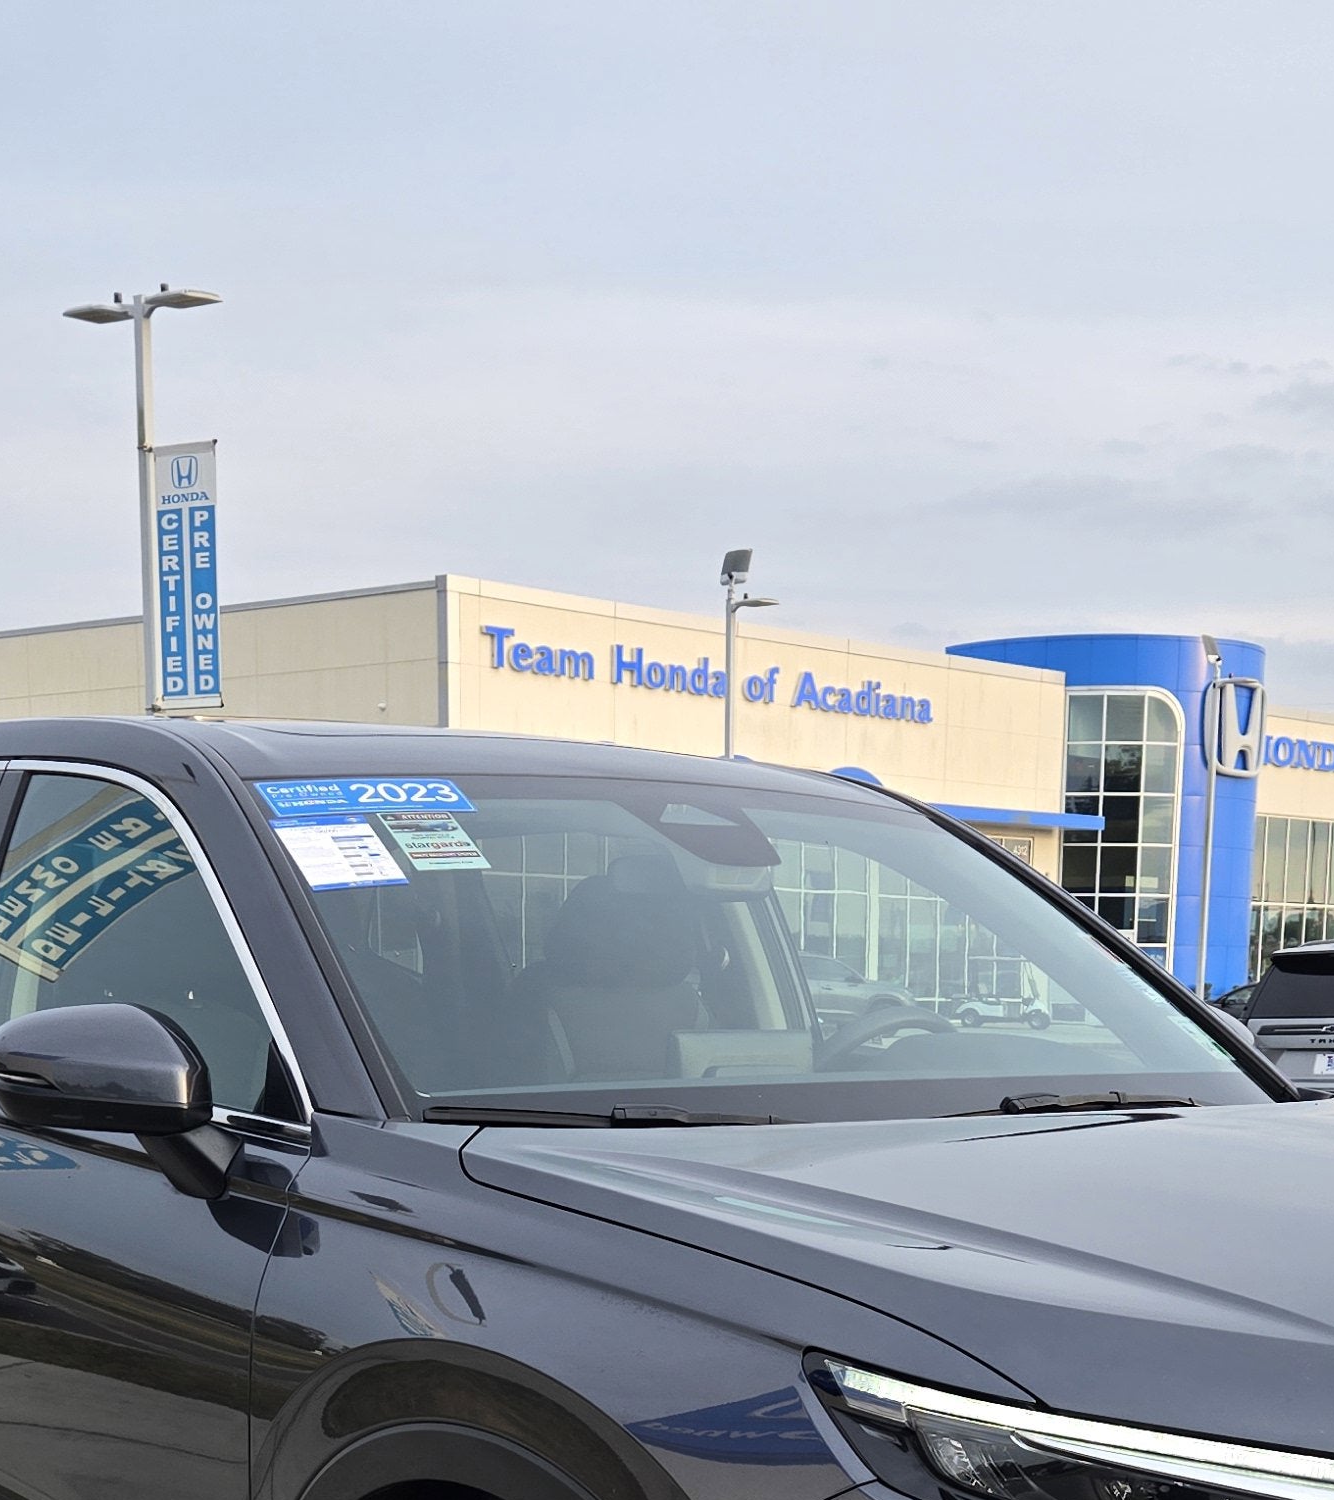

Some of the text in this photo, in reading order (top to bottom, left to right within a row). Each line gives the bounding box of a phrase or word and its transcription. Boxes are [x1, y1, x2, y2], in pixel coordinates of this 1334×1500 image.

[161, 491, 209, 505] HONDA
[161, 513, 185, 693] CERTIFIED
[193, 510, 215, 691] PRE OWNED
[481, 624, 933, 724] Team Honda of Acadiana
[349, 783, 459, 803] 2023
